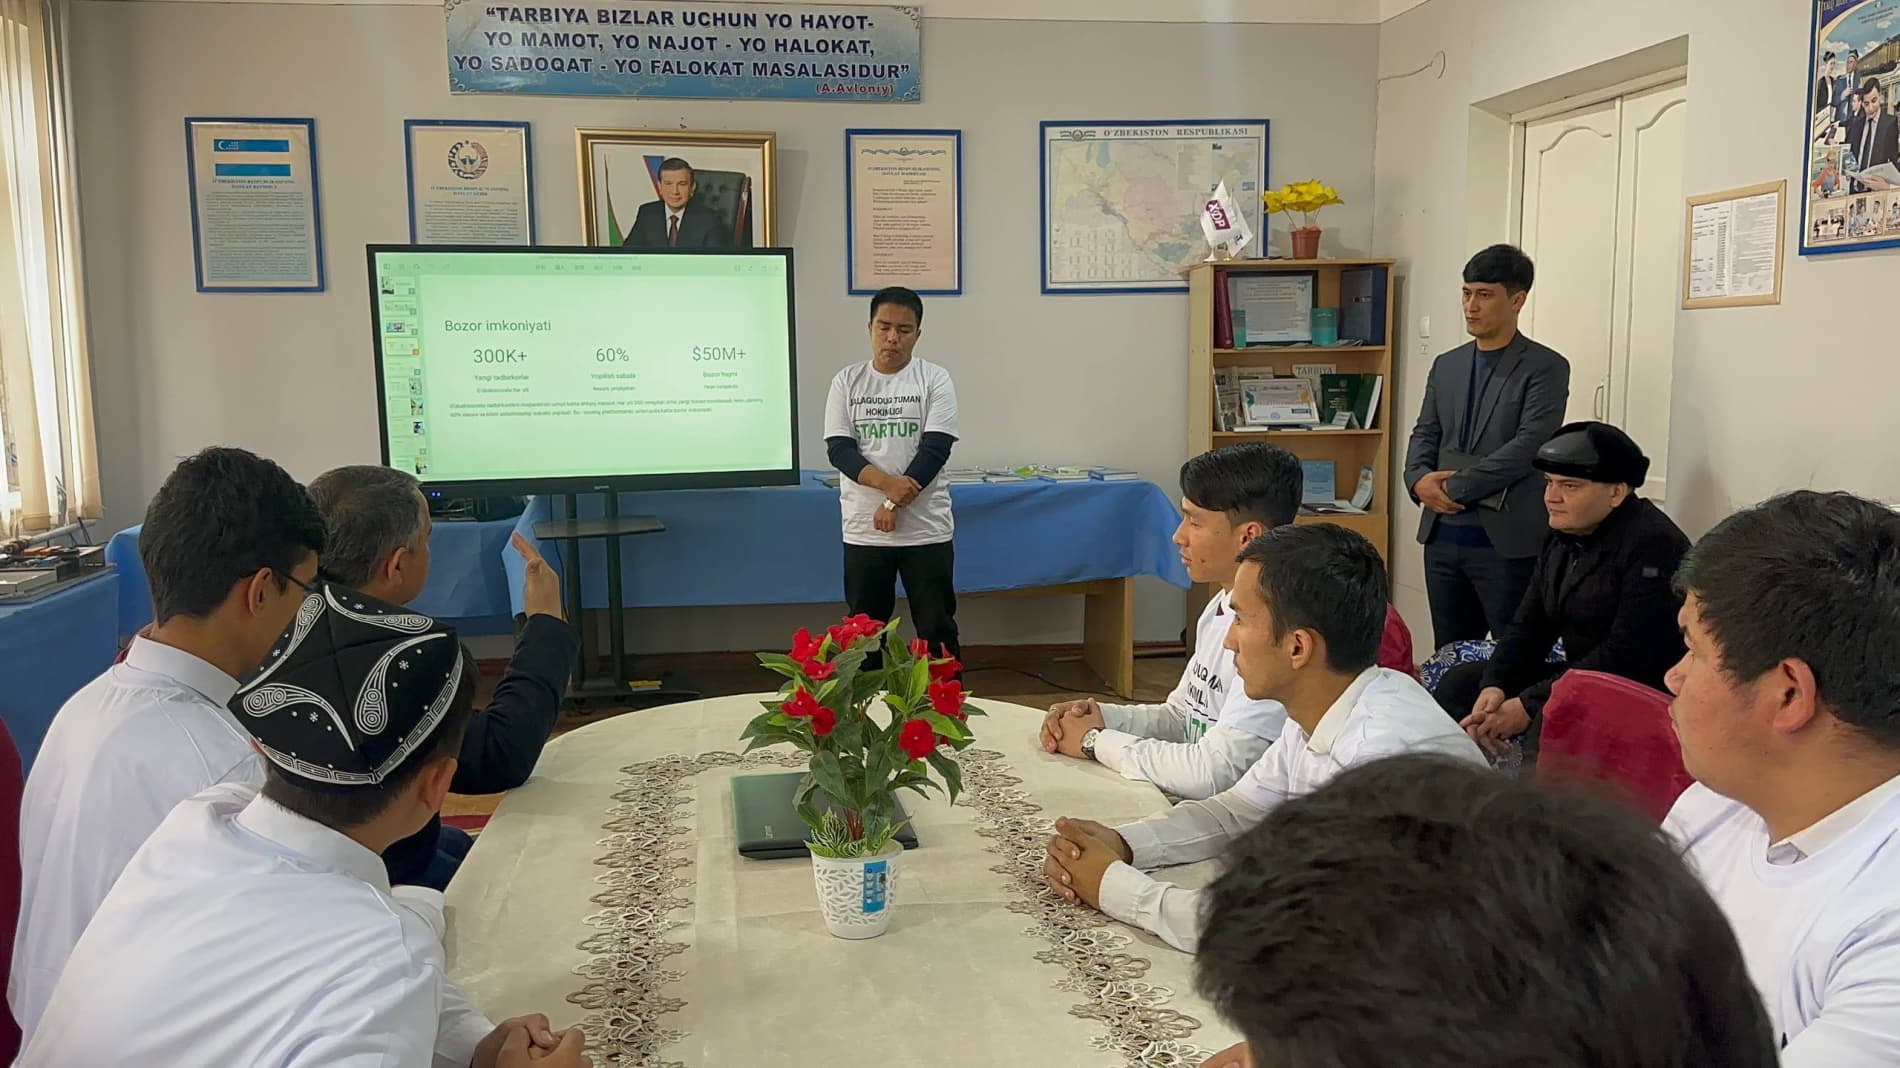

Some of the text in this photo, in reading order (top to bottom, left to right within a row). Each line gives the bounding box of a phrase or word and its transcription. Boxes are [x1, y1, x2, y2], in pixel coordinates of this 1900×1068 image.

[486, 7, 874, 30] “TARBIYA BIZLAR UCHUN YO HAYOT-
[484, 32, 512, 46] YO
[521, 32, 603, 51] MAMOT,
[612, 34, 640, 49] YO
[648, 36, 717, 51] NAJOT
[739, 38, 766, 52] YO
[774, 38, 874, 57] HALOKAT,
[454, 56, 482, 70] YO
[491, 56, 592, 73] SADOQAT
[615, 59, 642, 74] YO
[651, 60, 744, 76] FALOKAT
[752, 62, 910, 79] MASALASIDUR”
[816, 83, 894, 96] (A.Avloniy)
[1177, 127, 1248, 137] RESPUBLIKASI
[445, 320, 551, 333] Bozor imkoniyati
[473, 348, 528, 363] 300K+
[596, 348, 629, 362] 60%
[692, 346, 747, 361] $50M+
[894, 395, 920, 404] TUMAN
[855, 422, 919, 439] STARTUP
